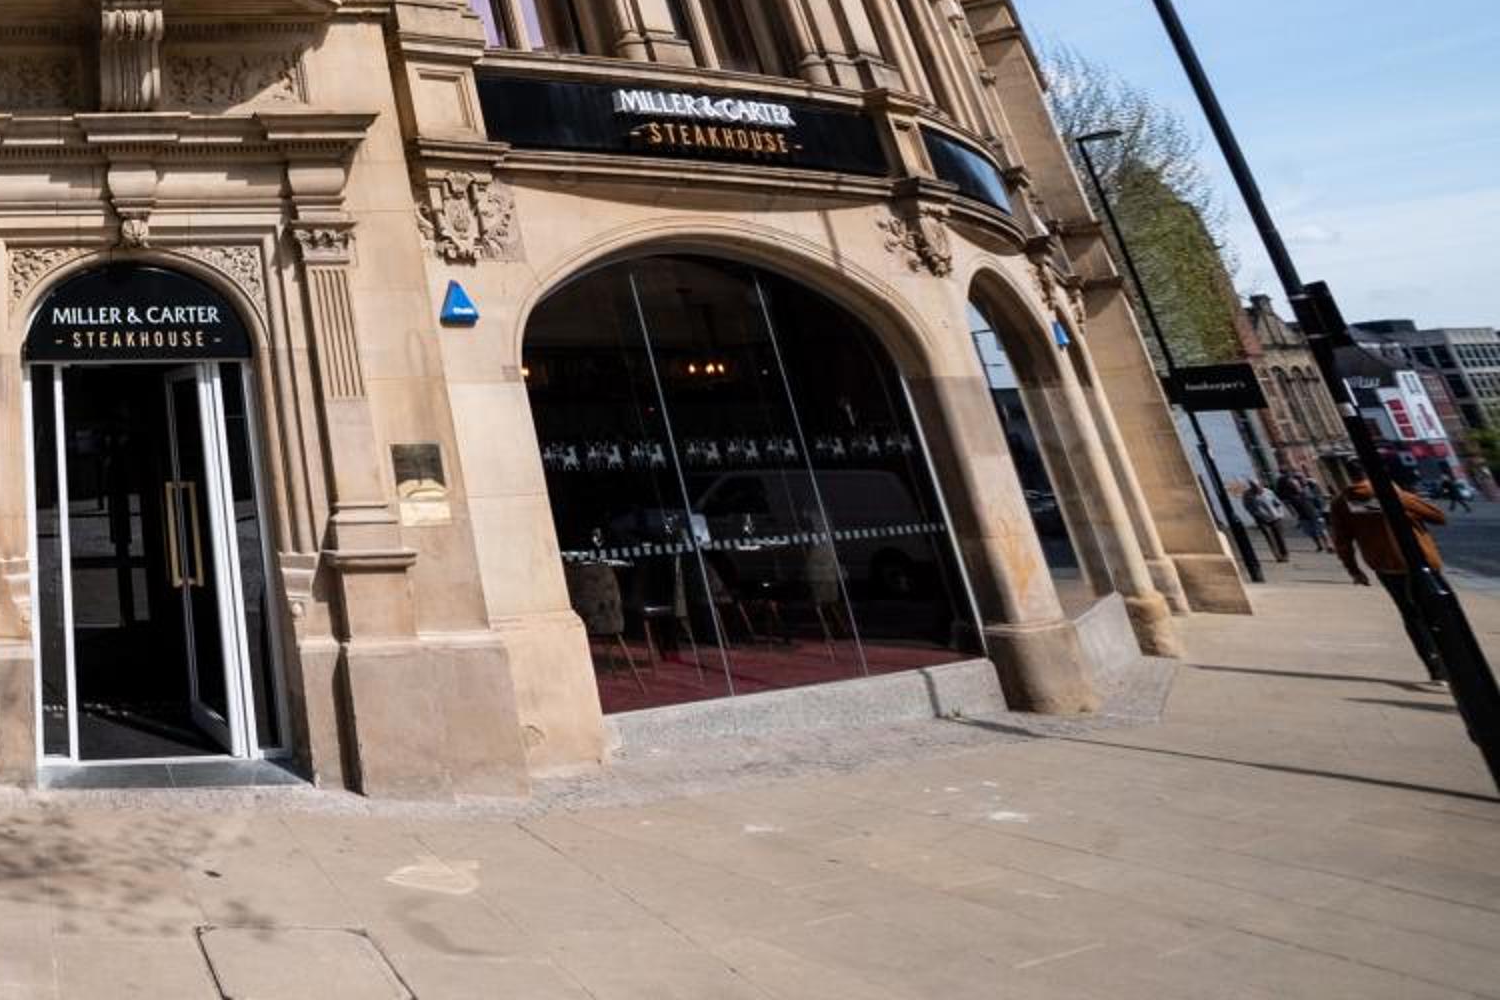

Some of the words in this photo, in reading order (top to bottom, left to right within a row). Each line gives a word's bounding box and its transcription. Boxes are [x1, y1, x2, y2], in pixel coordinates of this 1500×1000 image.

[616, 88, 700, 116] MILLER
[699, 95, 719, 119] &
[721, 99, 796, 126] CARTER
[651, 121, 789, 153] STEAKHOUSE
[52, 307, 122, 325] MILLER
[127, 306, 143, 324] &
[147, 306, 221, 323] CARTER
[73, 331, 205, 348] STEAKHOUSE
